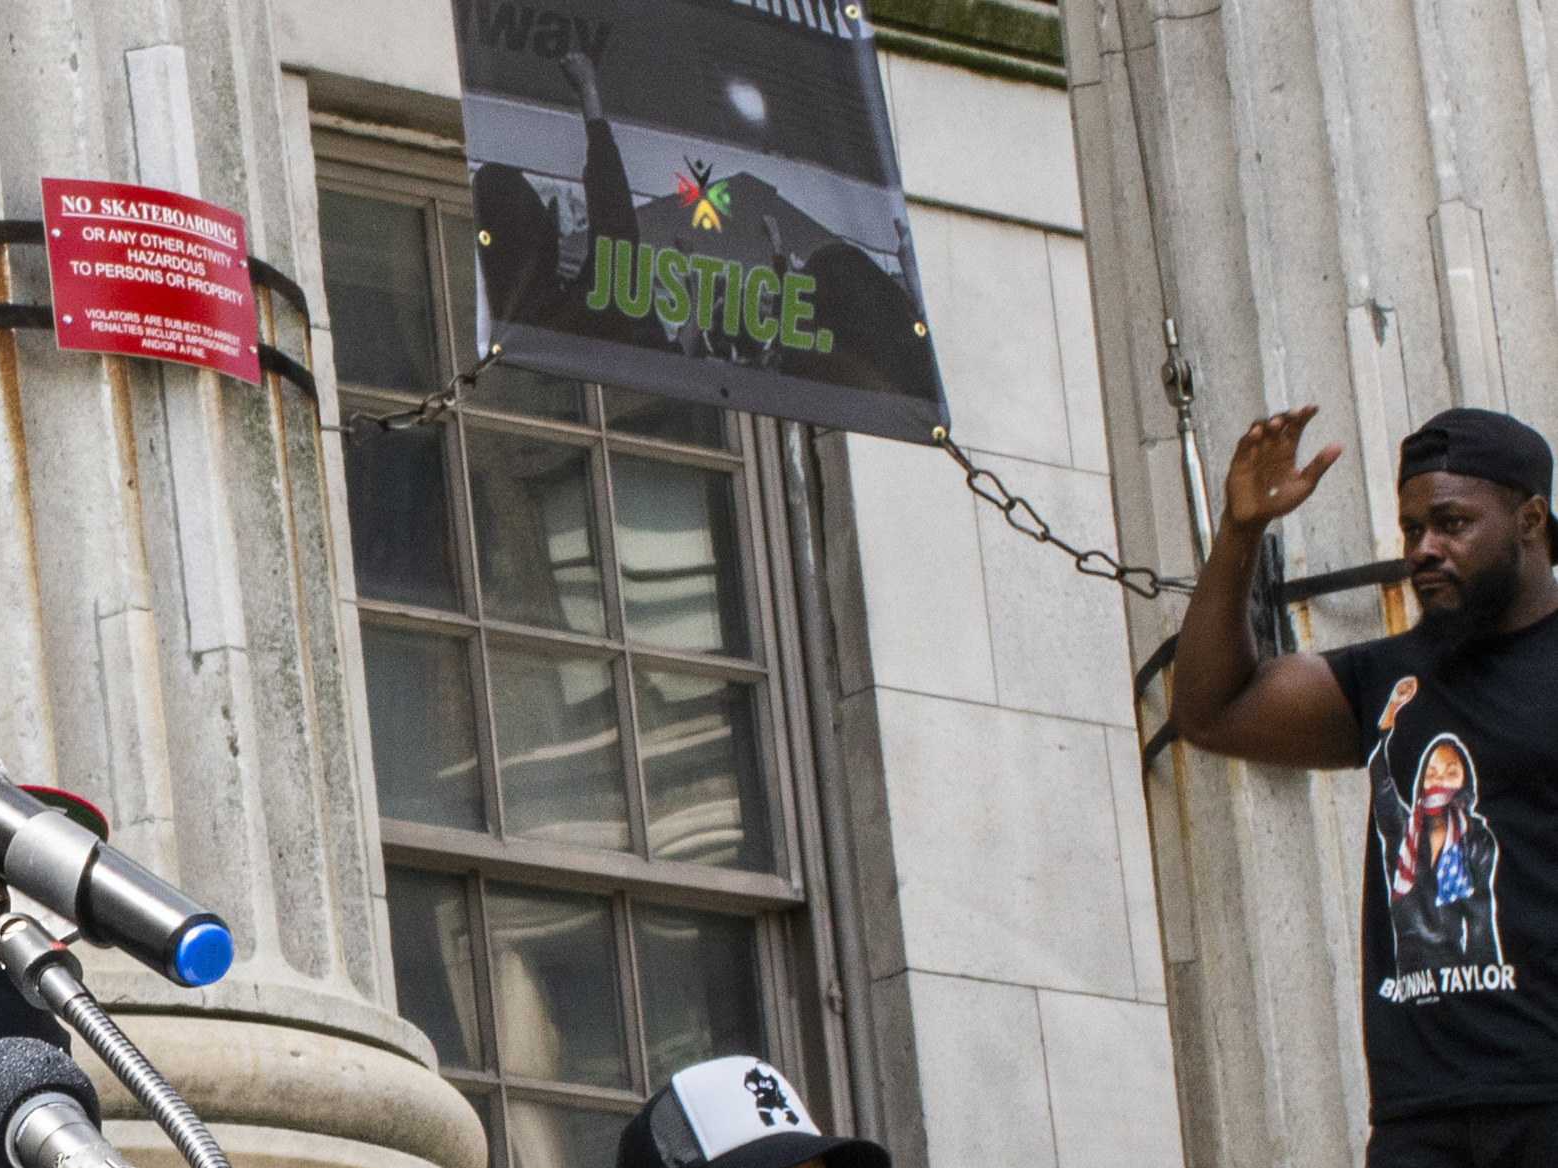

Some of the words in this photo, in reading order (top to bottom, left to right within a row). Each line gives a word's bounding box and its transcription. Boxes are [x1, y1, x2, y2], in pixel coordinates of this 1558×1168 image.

[60, 195, 92, 214] NO
[100, 198, 237, 246] SKATEBOARDING
[82, 227, 105, 242] OR
[108, 229, 136, 245] ANY
[140, 233, 186, 253] OTHER
[186, 243, 232, 268] ACTIVITY
[127, 249, 206, 276] HAZARDOUS
[70, 261, 92, 276] TO
[95, 263, 163, 284] PERSONS
[166, 273, 186, 289] OR
[187, 277, 243, 306] PROPERTY
[587, 236, 833, 354] JUSTICE.
[85, 309, 141, 323] VIOLATORS
[144, 315, 163, 326] ARE
[164, 318, 201, 334] SUBJECT
[203, 325, 213, 337] TO
[91, 321, 143, 336] PENALTIES
[145, 327, 184, 343] INCLUDE
[142, 338, 176, 352] AND/OR
[1440, 964, 1516, 993] TAYLOR
